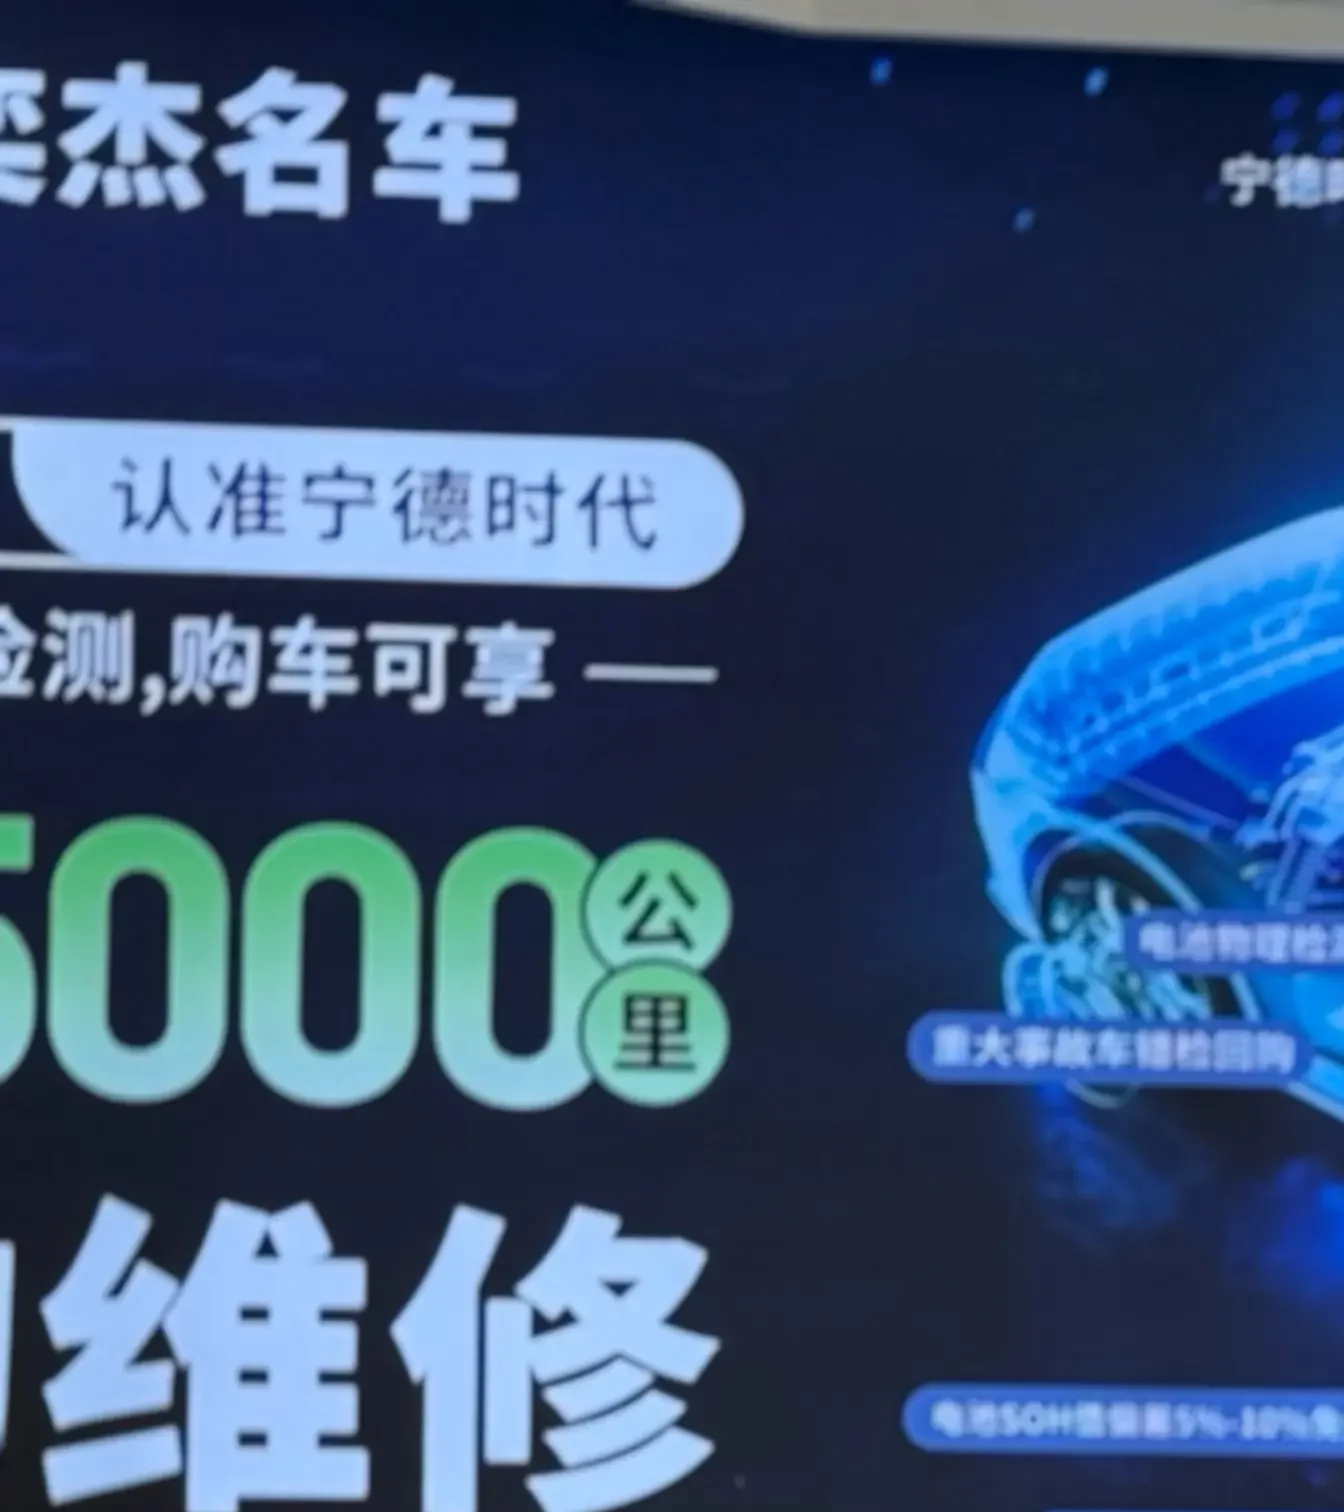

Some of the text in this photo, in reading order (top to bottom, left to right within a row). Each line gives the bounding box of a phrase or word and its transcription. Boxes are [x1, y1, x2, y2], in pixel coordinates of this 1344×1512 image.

[111, 456, 658, 553] 认准宁德时代
[0, 815, 601, 1111] 000
[612, 871, 698, 1073] 公里
